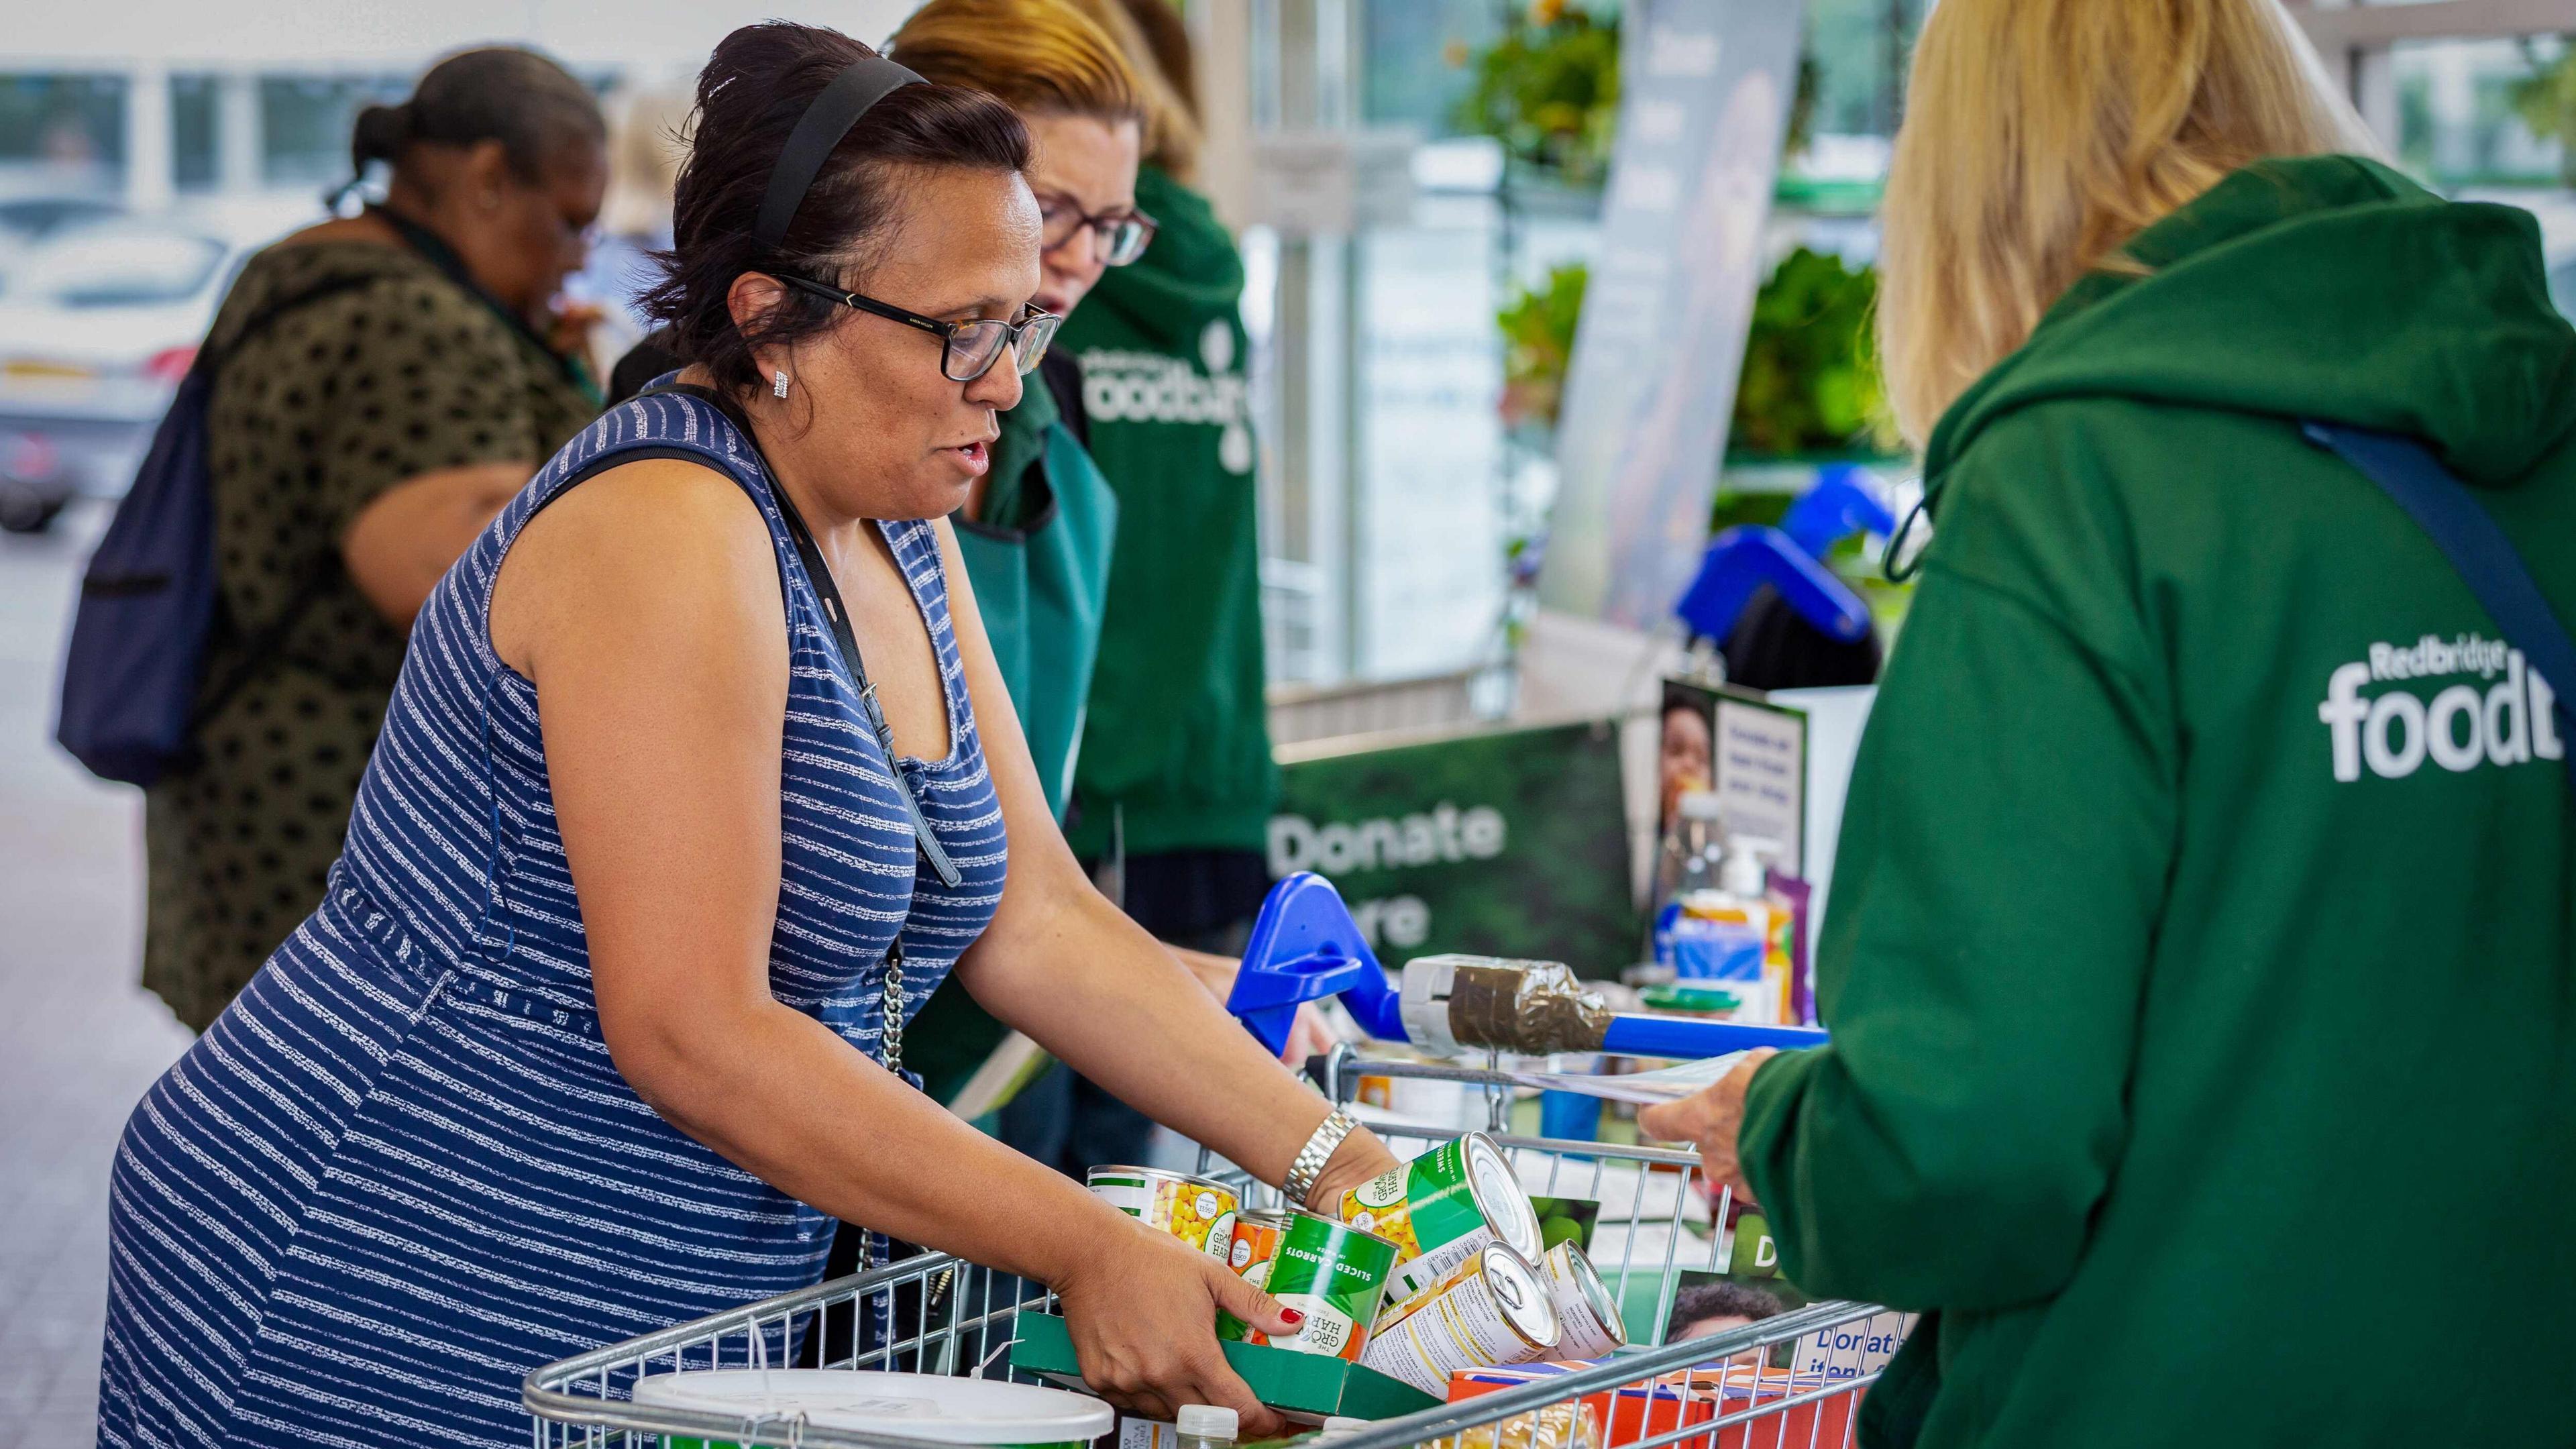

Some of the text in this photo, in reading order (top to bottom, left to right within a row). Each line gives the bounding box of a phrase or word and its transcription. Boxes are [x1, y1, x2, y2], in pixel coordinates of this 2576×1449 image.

[2369, 632, 2509, 680] Redbridge
[1267, 801, 1508, 880] Donate
[1199, 1205, 1214, 1213] TESCO
[1316, 1246, 1337, 1256] WATER
[1451, 1237, 1474, 1252] 059512
[1285, 1246, 1372, 1281] SLICED CARROTS
[1427, 1248, 1450, 1263] 741685
[1463, 1283, 1474, 1304] MICROWAVE
[1467, 1280, 1490, 1322] HEATING INSTRUCTIONS
[1476, 1287, 1488, 1307] vegetables
[1466, 1302, 1477, 1319] contents
[1569, 1306, 1582, 1327] INGREDIENTS
[1400, 1324, 1408, 1340] STORAGE
[1424, 1321, 1434, 1337] contents
[1468, 1318, 1481, 1334] ensuring
[1562, 1322, 1571, 1336] Suitable
[1317, 1343, 1330, 1352] THE
[1403, 1354, 1414, 1370] contents
